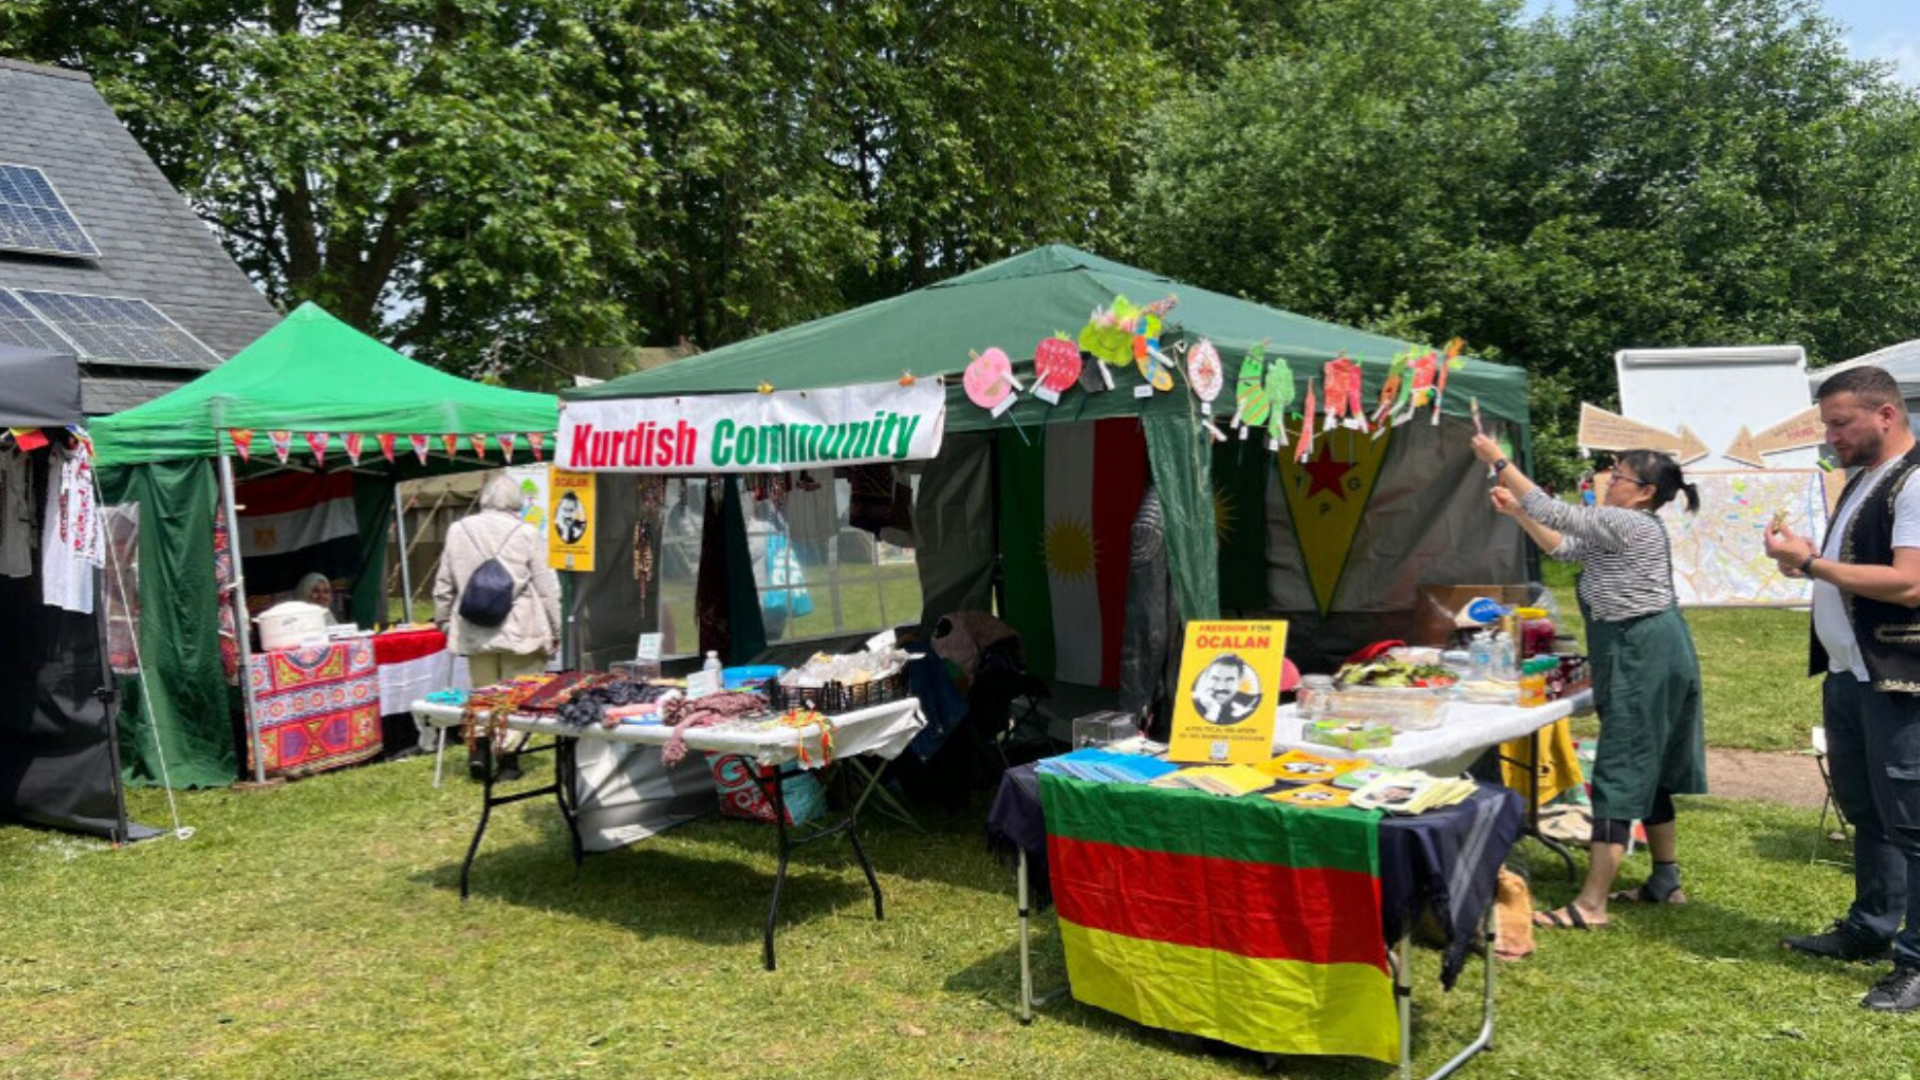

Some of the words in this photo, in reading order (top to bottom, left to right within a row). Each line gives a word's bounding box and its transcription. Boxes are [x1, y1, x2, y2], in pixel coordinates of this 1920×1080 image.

[570, 419, 697, 467] Kurdish
[711, 411, 922, 466] Community
[1251, 624, 1272, 632] FOR
